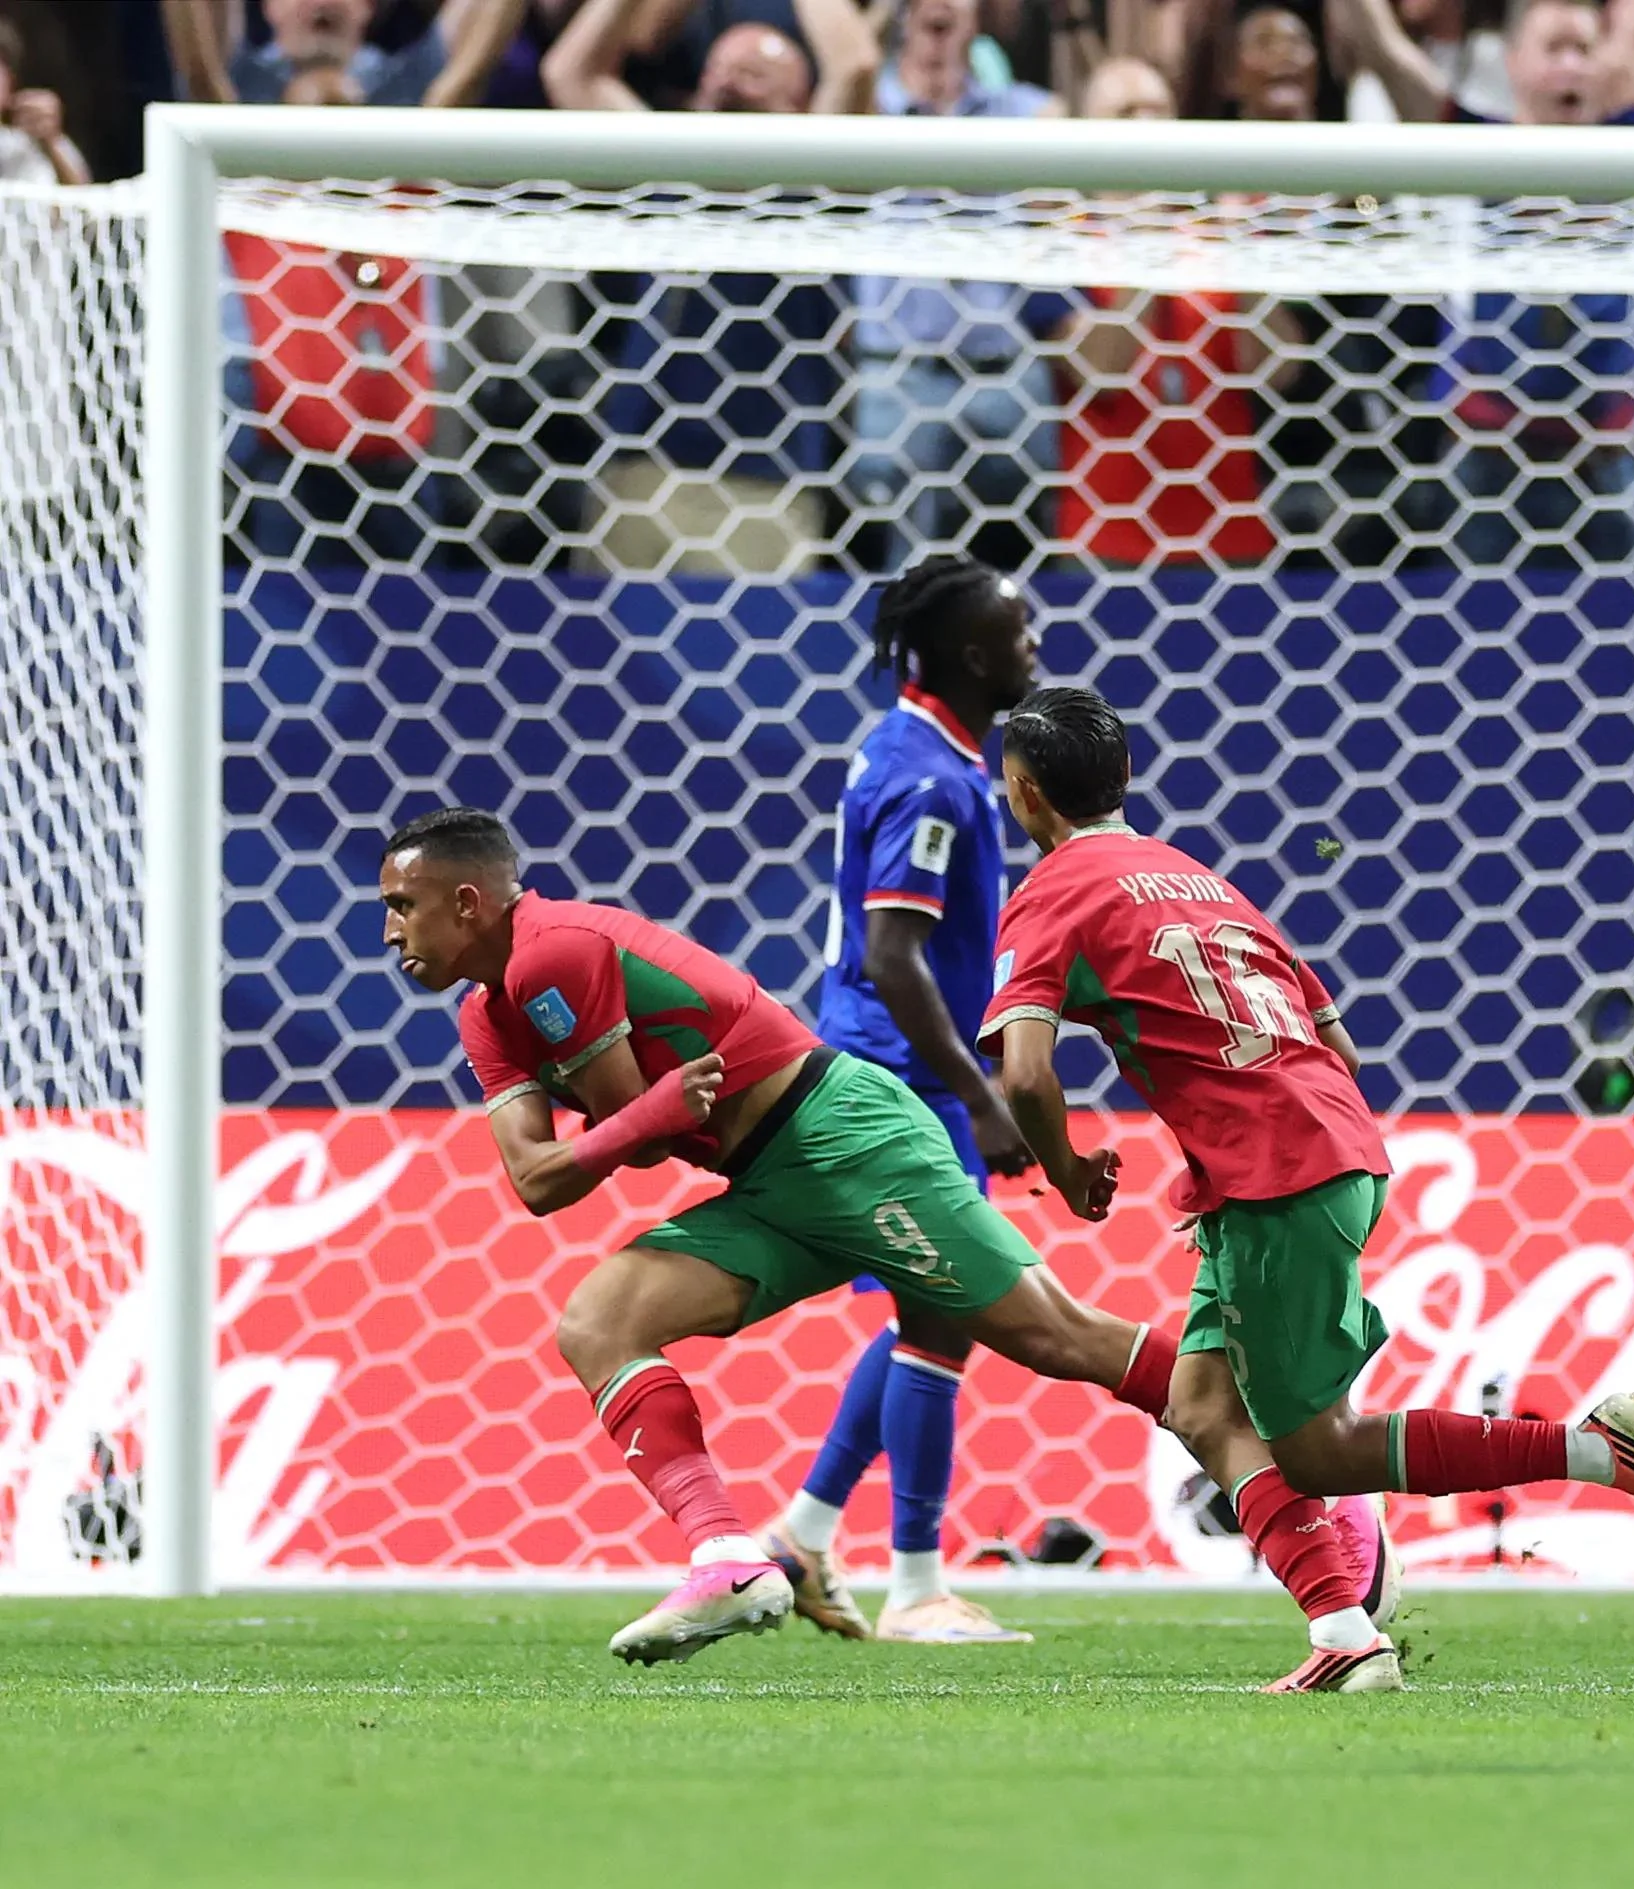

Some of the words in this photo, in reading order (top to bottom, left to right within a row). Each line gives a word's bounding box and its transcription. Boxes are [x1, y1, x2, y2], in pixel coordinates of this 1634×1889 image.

[1116, 872, 1234, 905] YASSINE
[1148, 919, 1313, 1070] 16
[873, 1199, 940, 1276] 9
